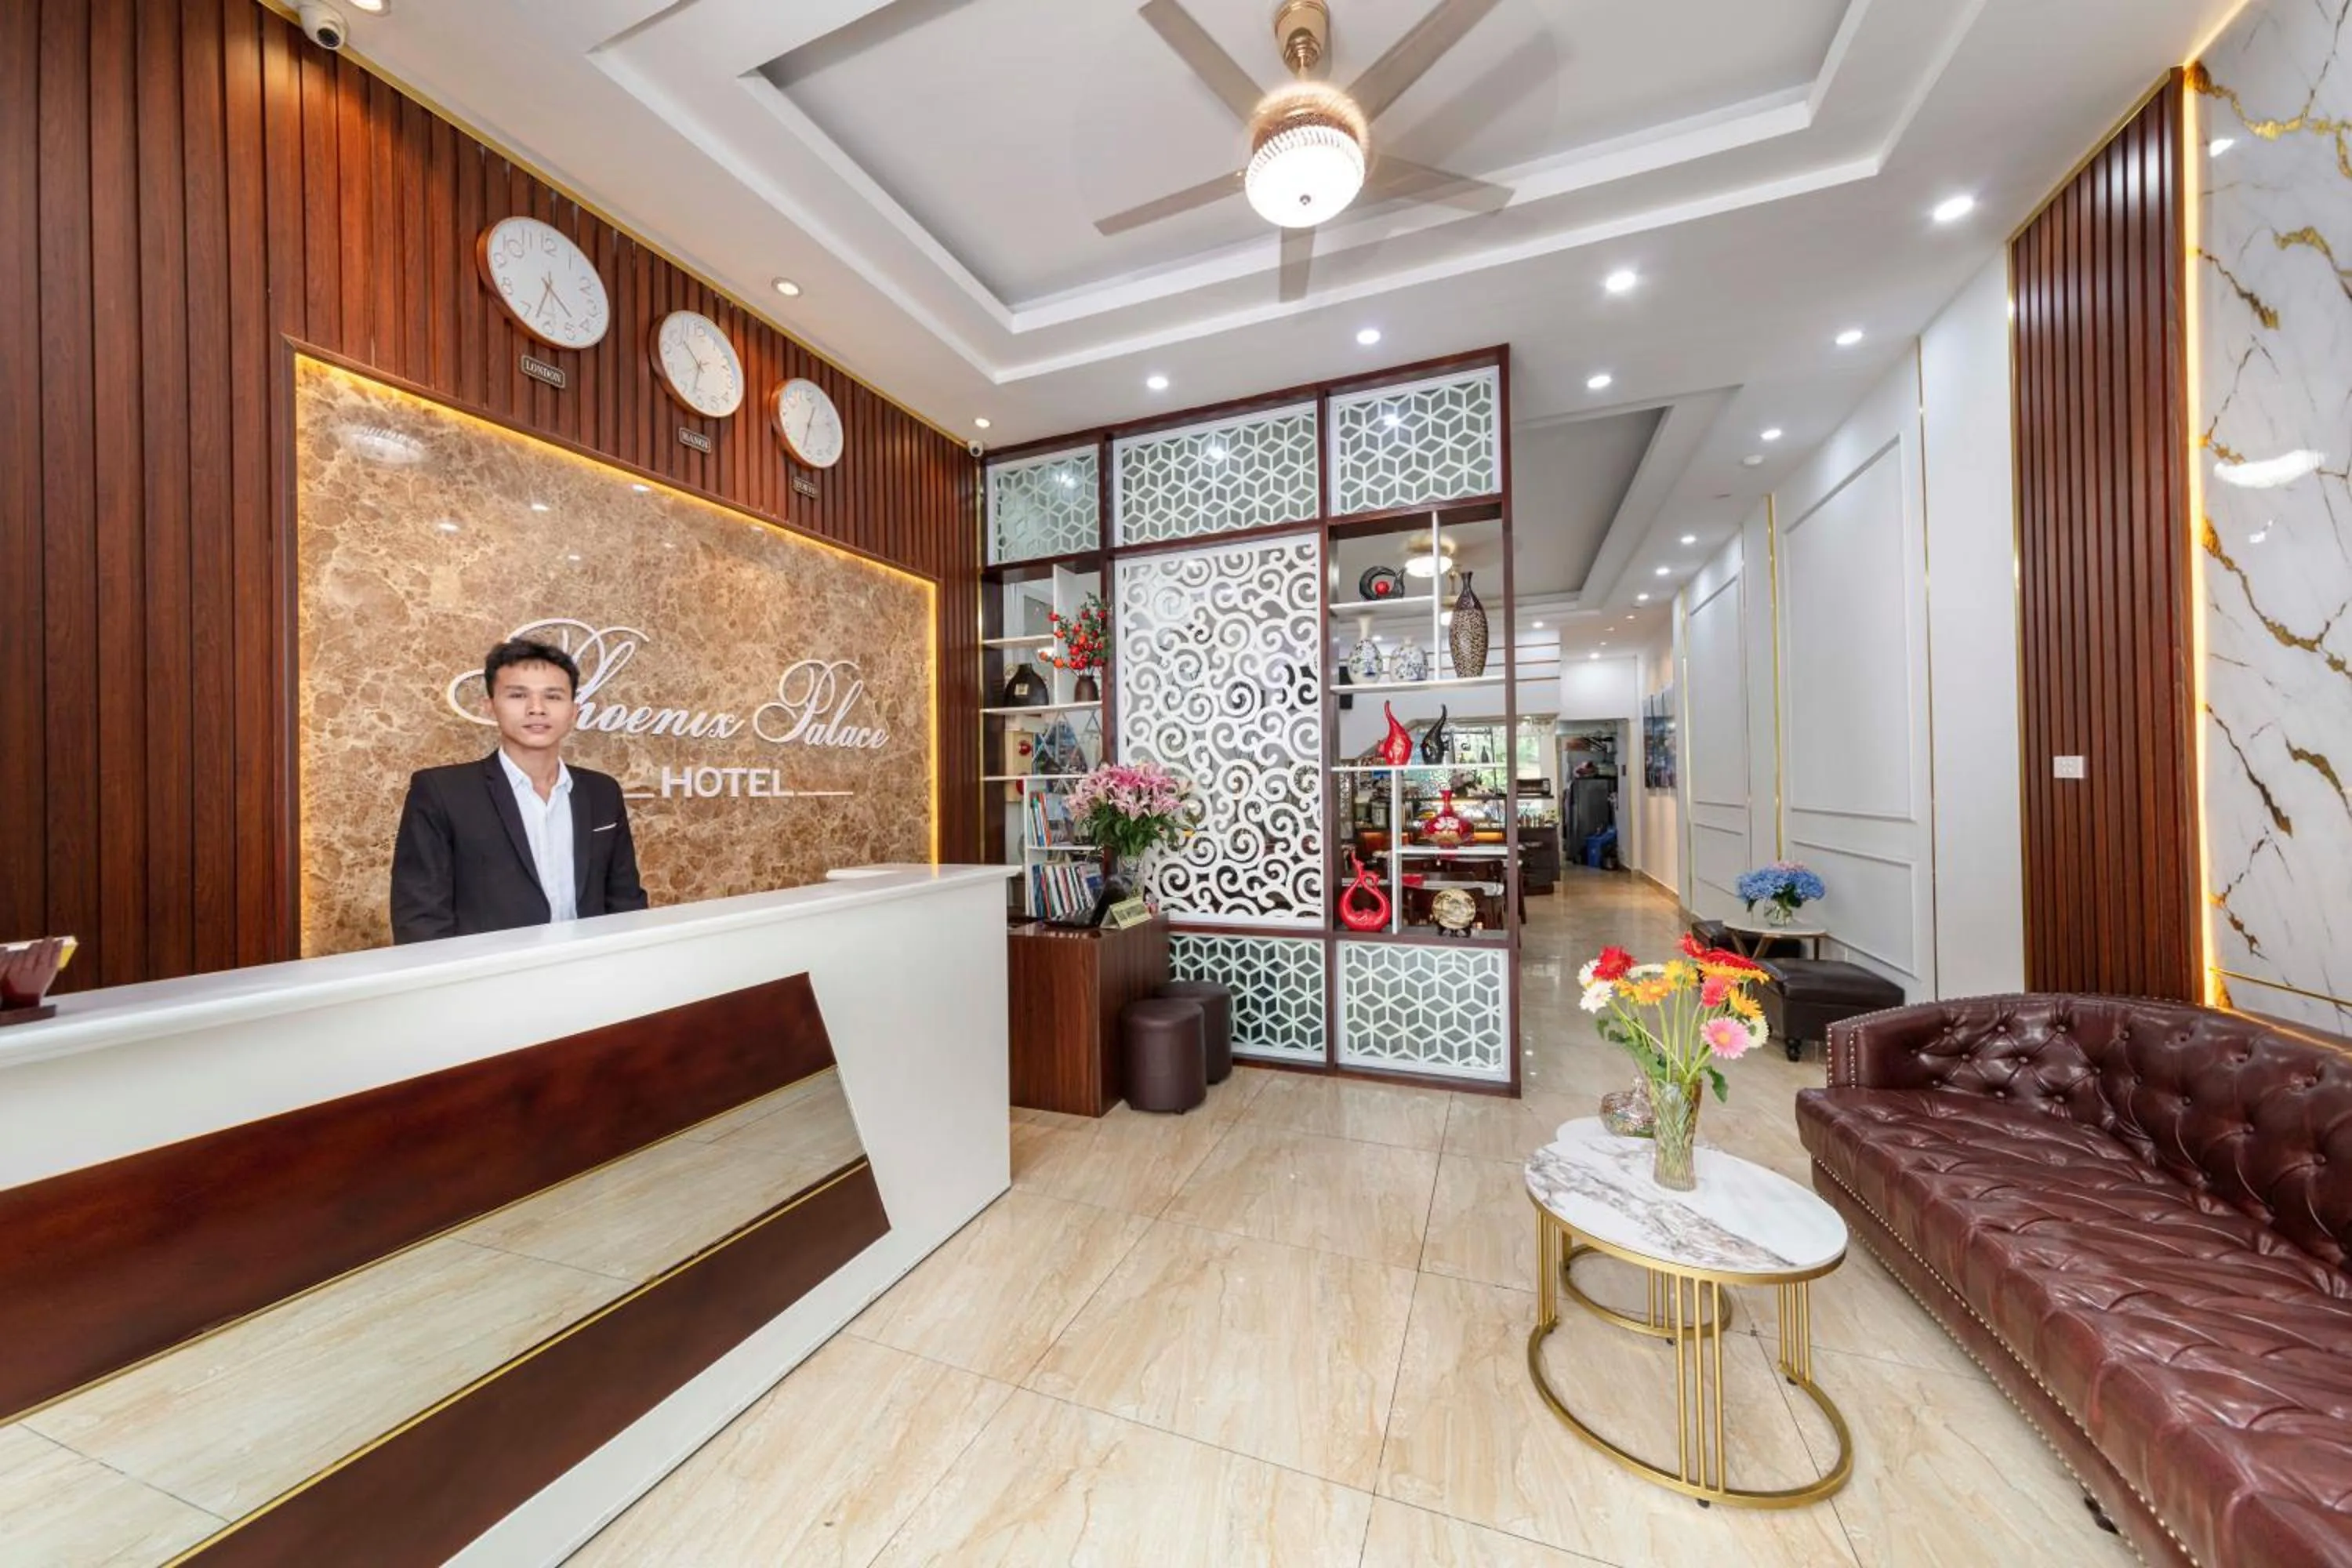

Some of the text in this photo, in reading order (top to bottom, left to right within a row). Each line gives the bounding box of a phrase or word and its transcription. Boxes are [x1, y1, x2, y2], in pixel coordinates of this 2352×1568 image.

[525, 359, 562, 383] LONDON
[753, 659, 890, 750] Palace
[661, 765, 794, 799] HOTEL
